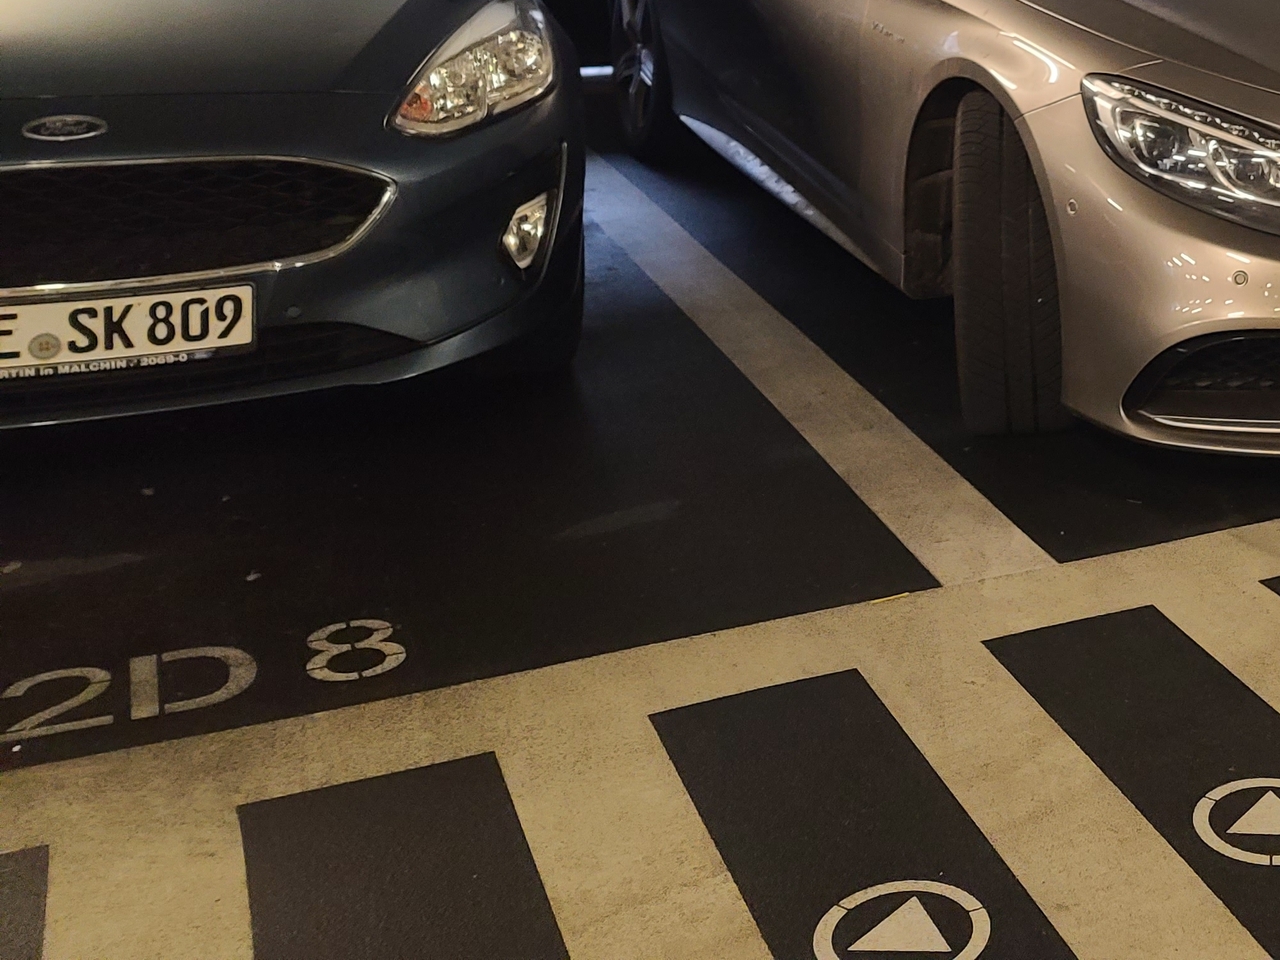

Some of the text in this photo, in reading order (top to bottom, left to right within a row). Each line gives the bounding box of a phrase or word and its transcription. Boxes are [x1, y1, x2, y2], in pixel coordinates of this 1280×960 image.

[67, 304, 134, 354] SK
[147, 294, 243, 346] 809
[57, 359, 129, 375] MALCHIN
[0, 618, 407, 741] 2D 8
